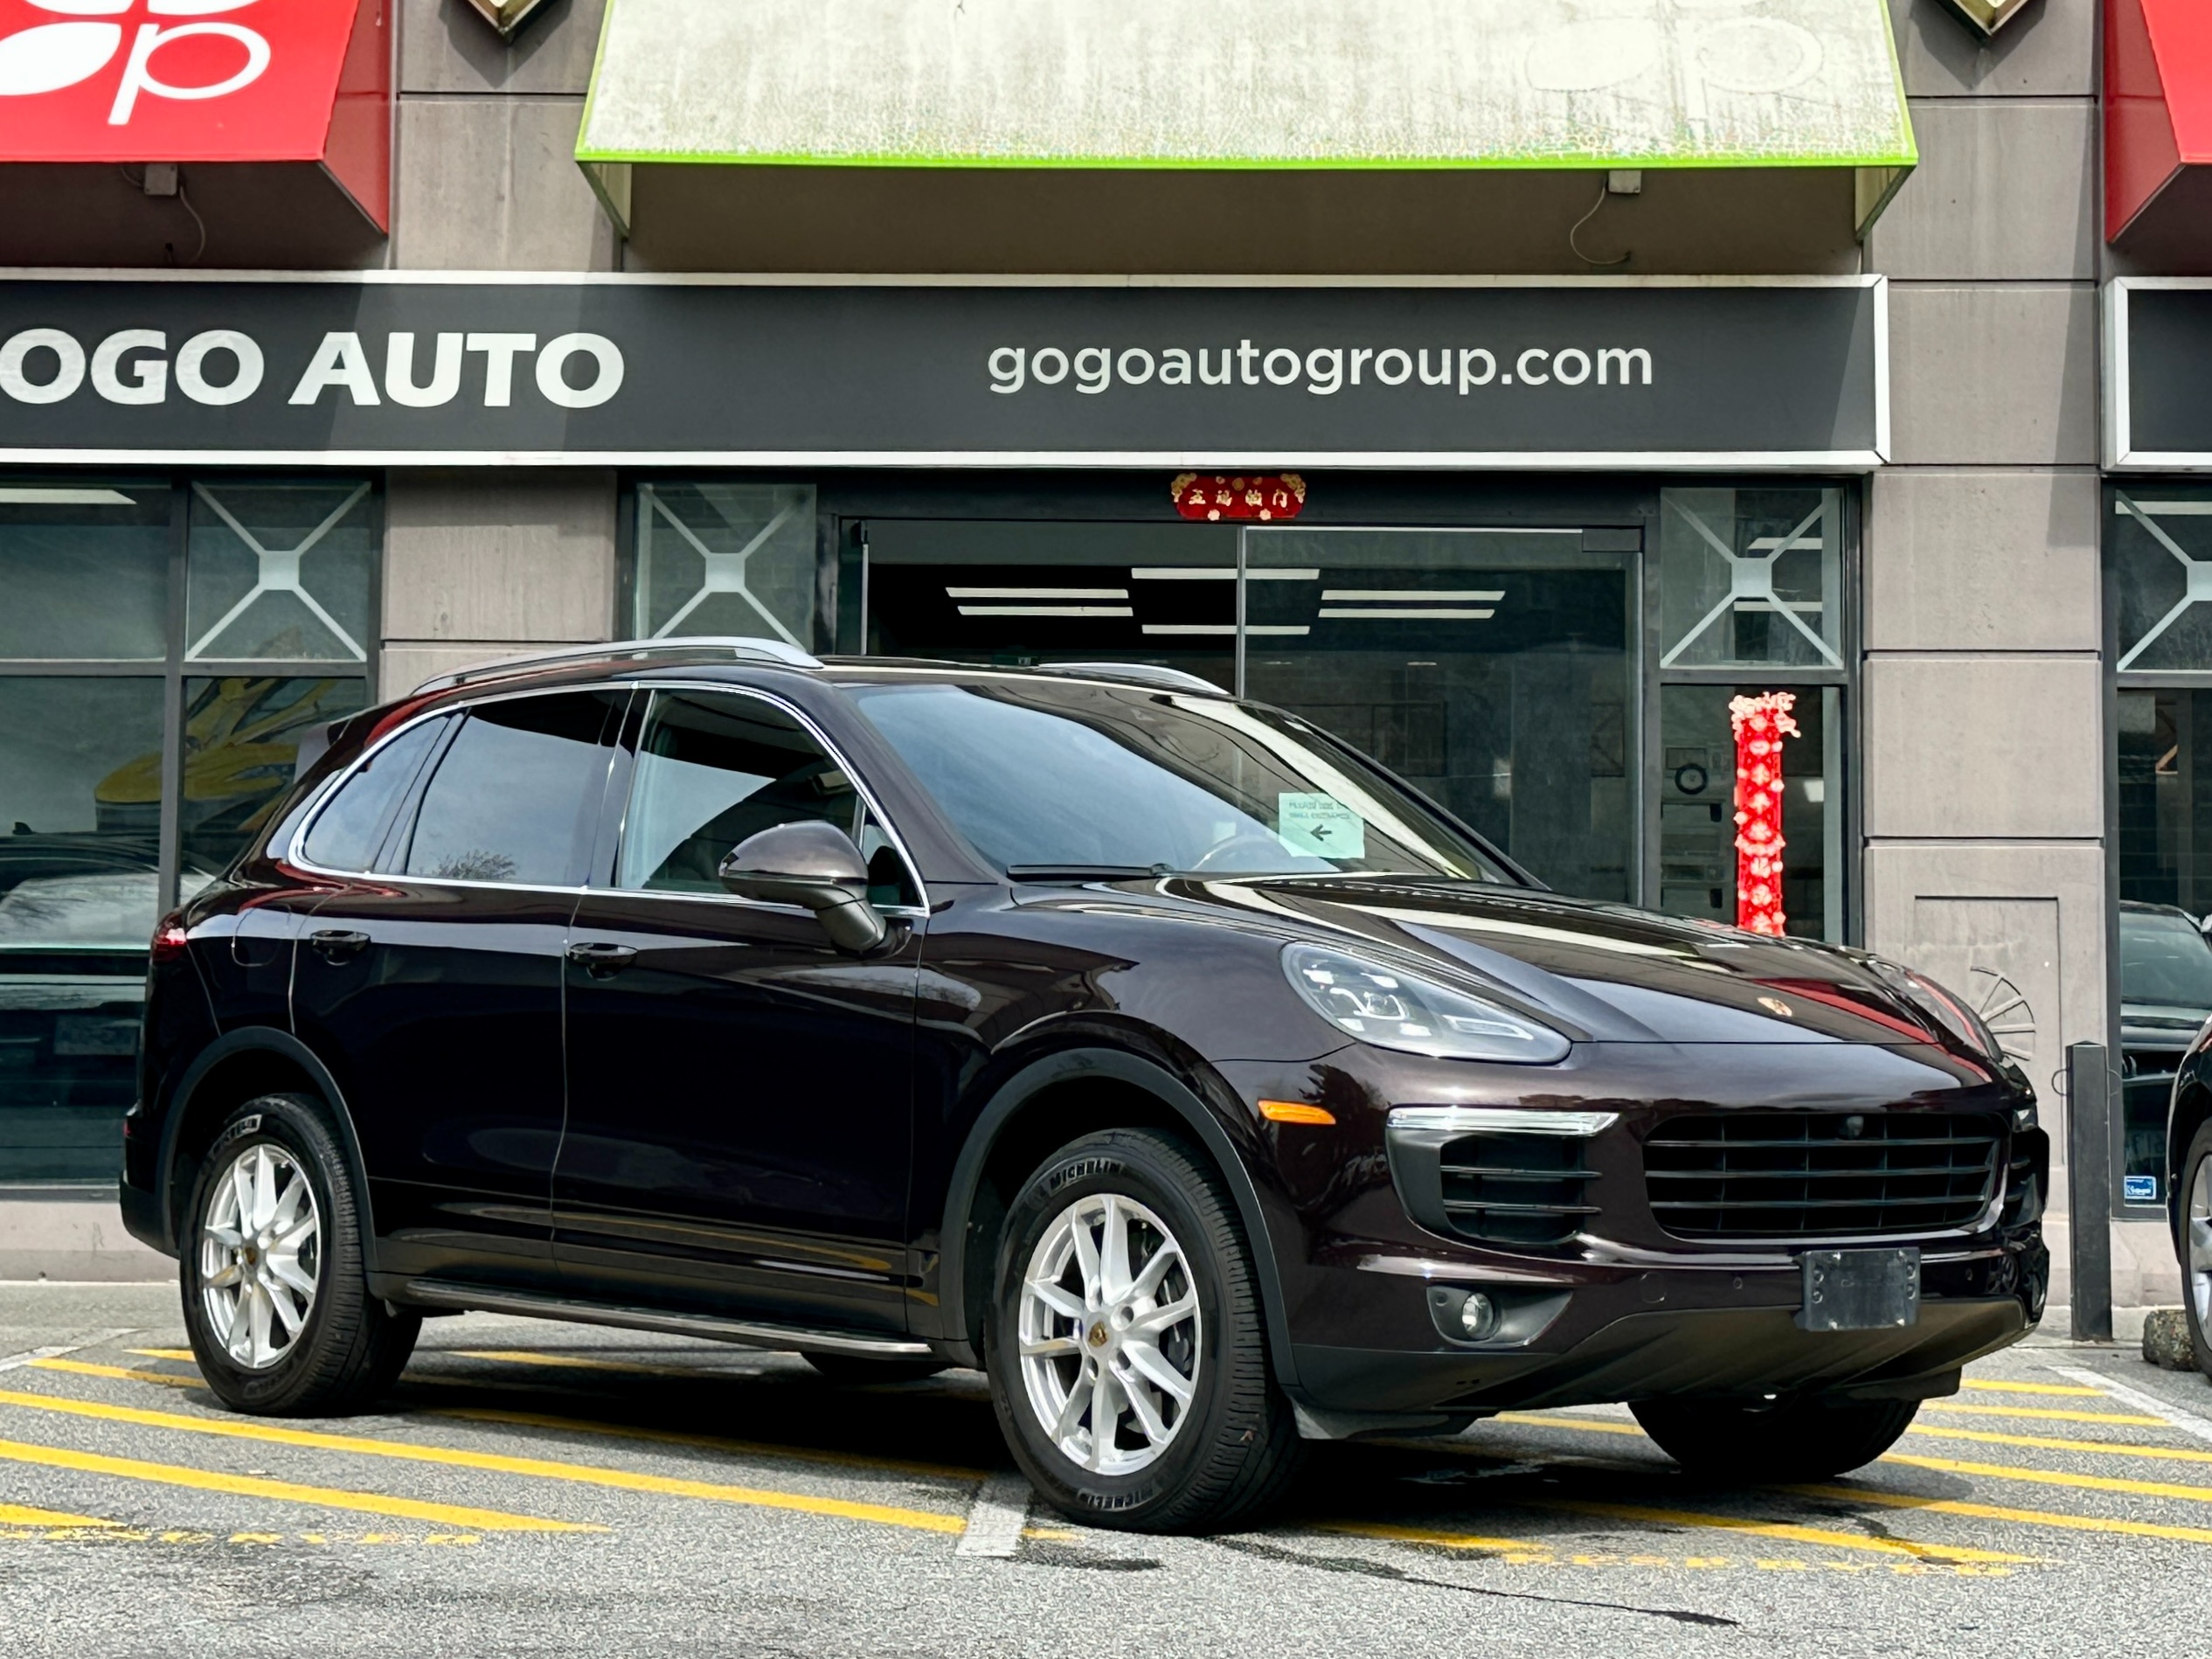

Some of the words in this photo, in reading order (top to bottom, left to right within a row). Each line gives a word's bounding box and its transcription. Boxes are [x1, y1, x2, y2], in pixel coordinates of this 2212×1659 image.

[0, 328, 265, 405] OGO
[288, 331, 624, 408] AUTO
[988, 338, 1654, 395] gogoautogroup.com
[1050, 1158, 1122, 1191] MICHELIN
